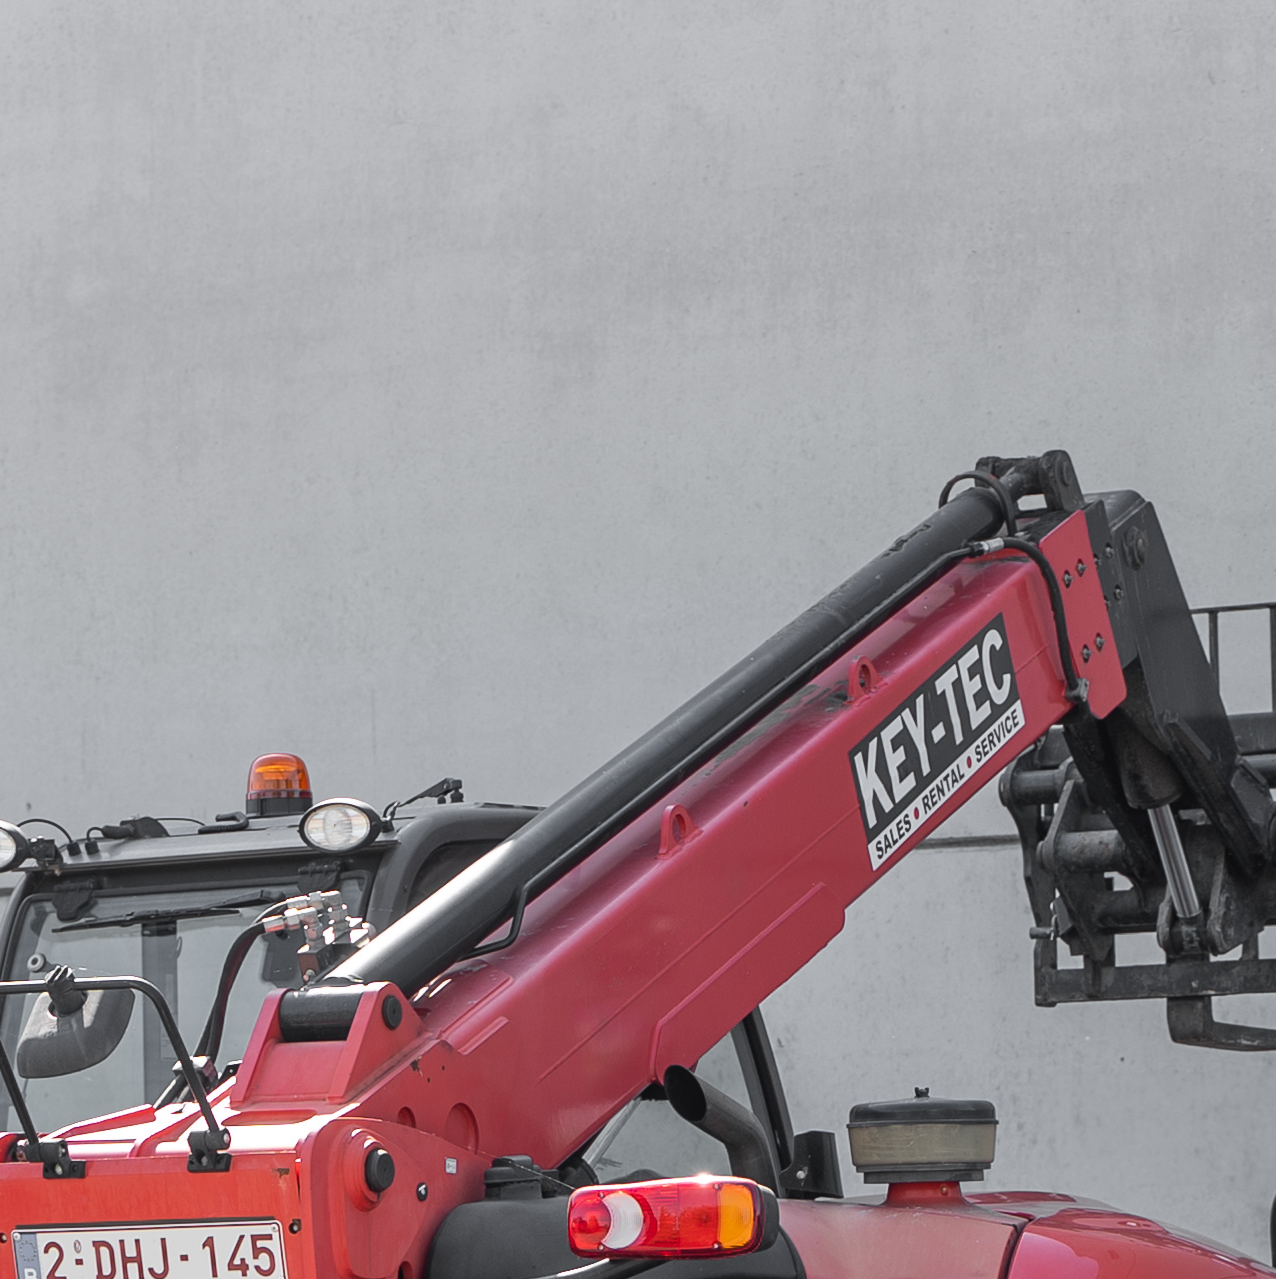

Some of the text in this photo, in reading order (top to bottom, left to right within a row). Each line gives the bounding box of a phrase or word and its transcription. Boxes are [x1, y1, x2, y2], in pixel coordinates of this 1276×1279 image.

[854, 628, 1011, 829] KEY-TEC
[875, 709, 1019, 859] SALES RENTAL SERVICE
